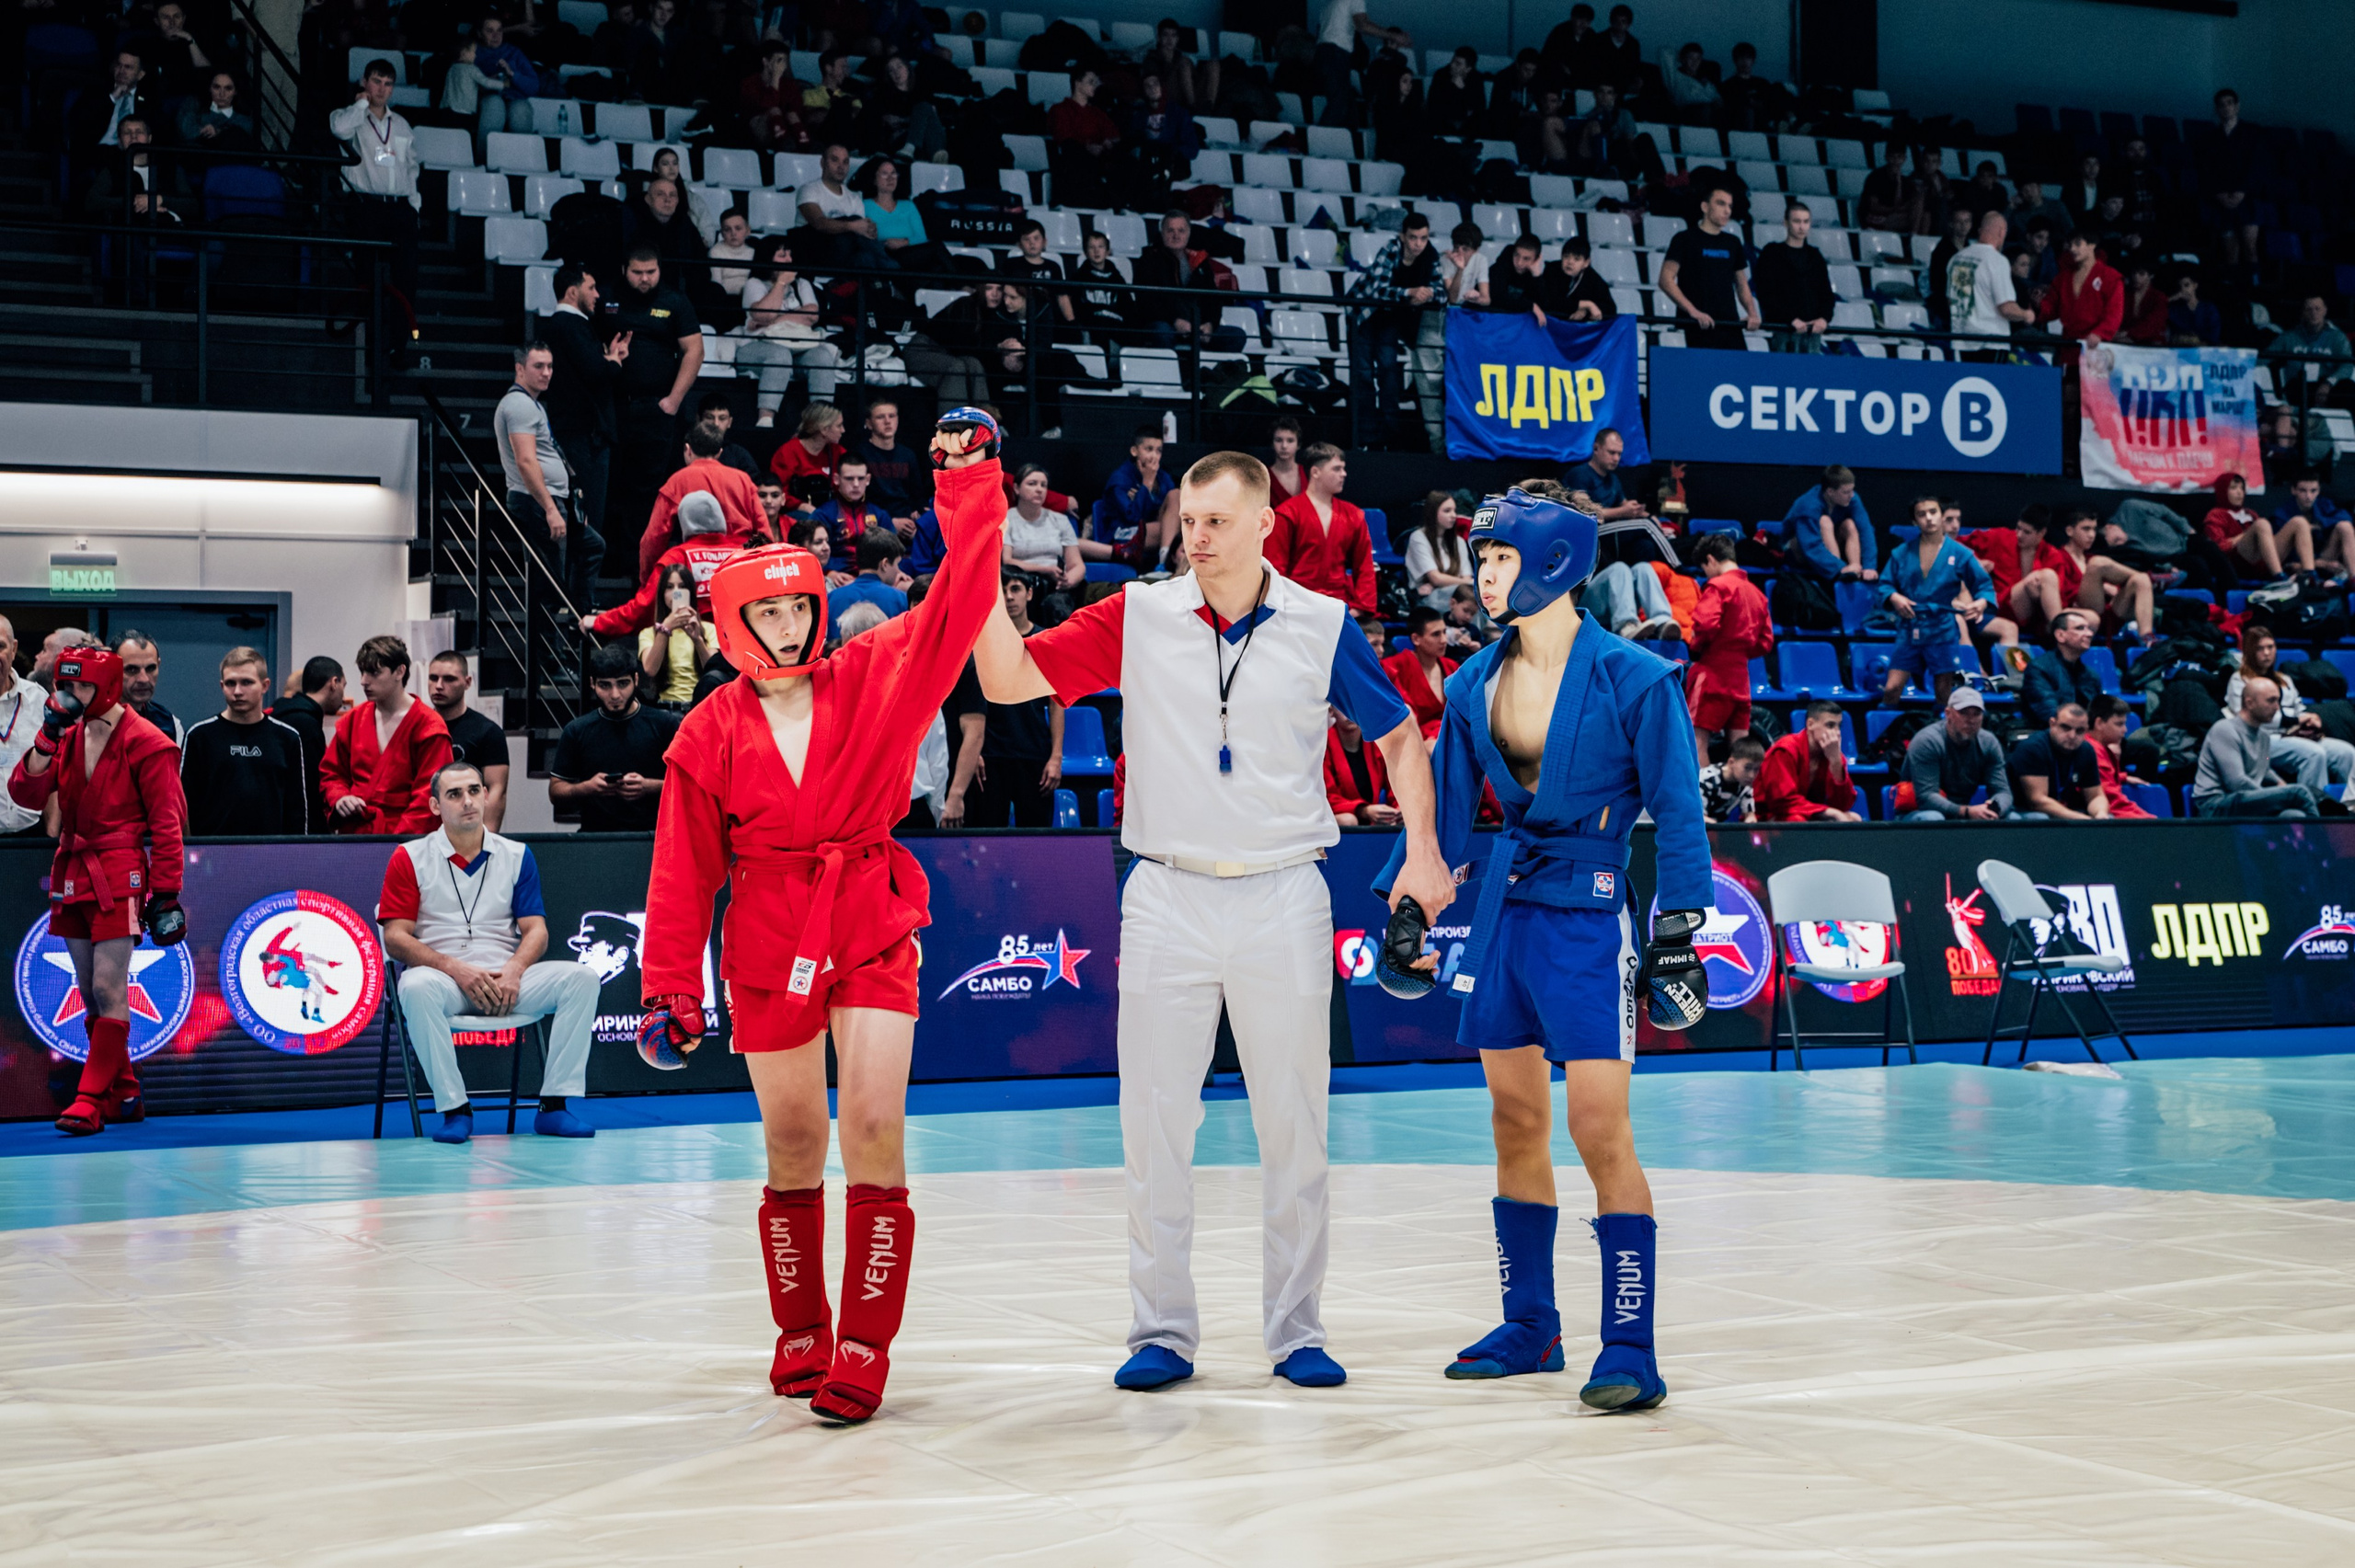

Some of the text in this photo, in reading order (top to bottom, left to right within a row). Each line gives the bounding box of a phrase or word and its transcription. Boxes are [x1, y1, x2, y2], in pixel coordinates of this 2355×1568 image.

[950, 219, 1013, 232] RUSSIA
[419, 357, 431, 370] 8
[1475, 363, 1606, 429] ЛДПР
[459, 414, 471, 429] 7
[1709, 383, 1994, 442] СЕКТОР В
[52, 569, 116, 592] ВЫХОД
[764, 558, 800, 586] clinch
[230, 745, 263, 757] FILA
[242, 898, 299, 931] областная
[2320, 905, 2342, 931] 85
[2151, 902, 2270, 967] ЛДПР
[2302, 939, 2349, 955] САМБО
[997, 934, 1054, 965] 85 лет
[1658, 956, 1688, 966] IMMAF
[1946, 947, 1974, 976] 80
[967, 976, 1032, 992] САМБО
[1678, 980, 1704, 1015] HILL
[1663, 983, 1696, 1023] GREEN
[769, 1217, 801, 1294] VENUM
[860, 1216, 898, 1301] VENUM
[1614, 1250, 1647, 1325] VENUM
